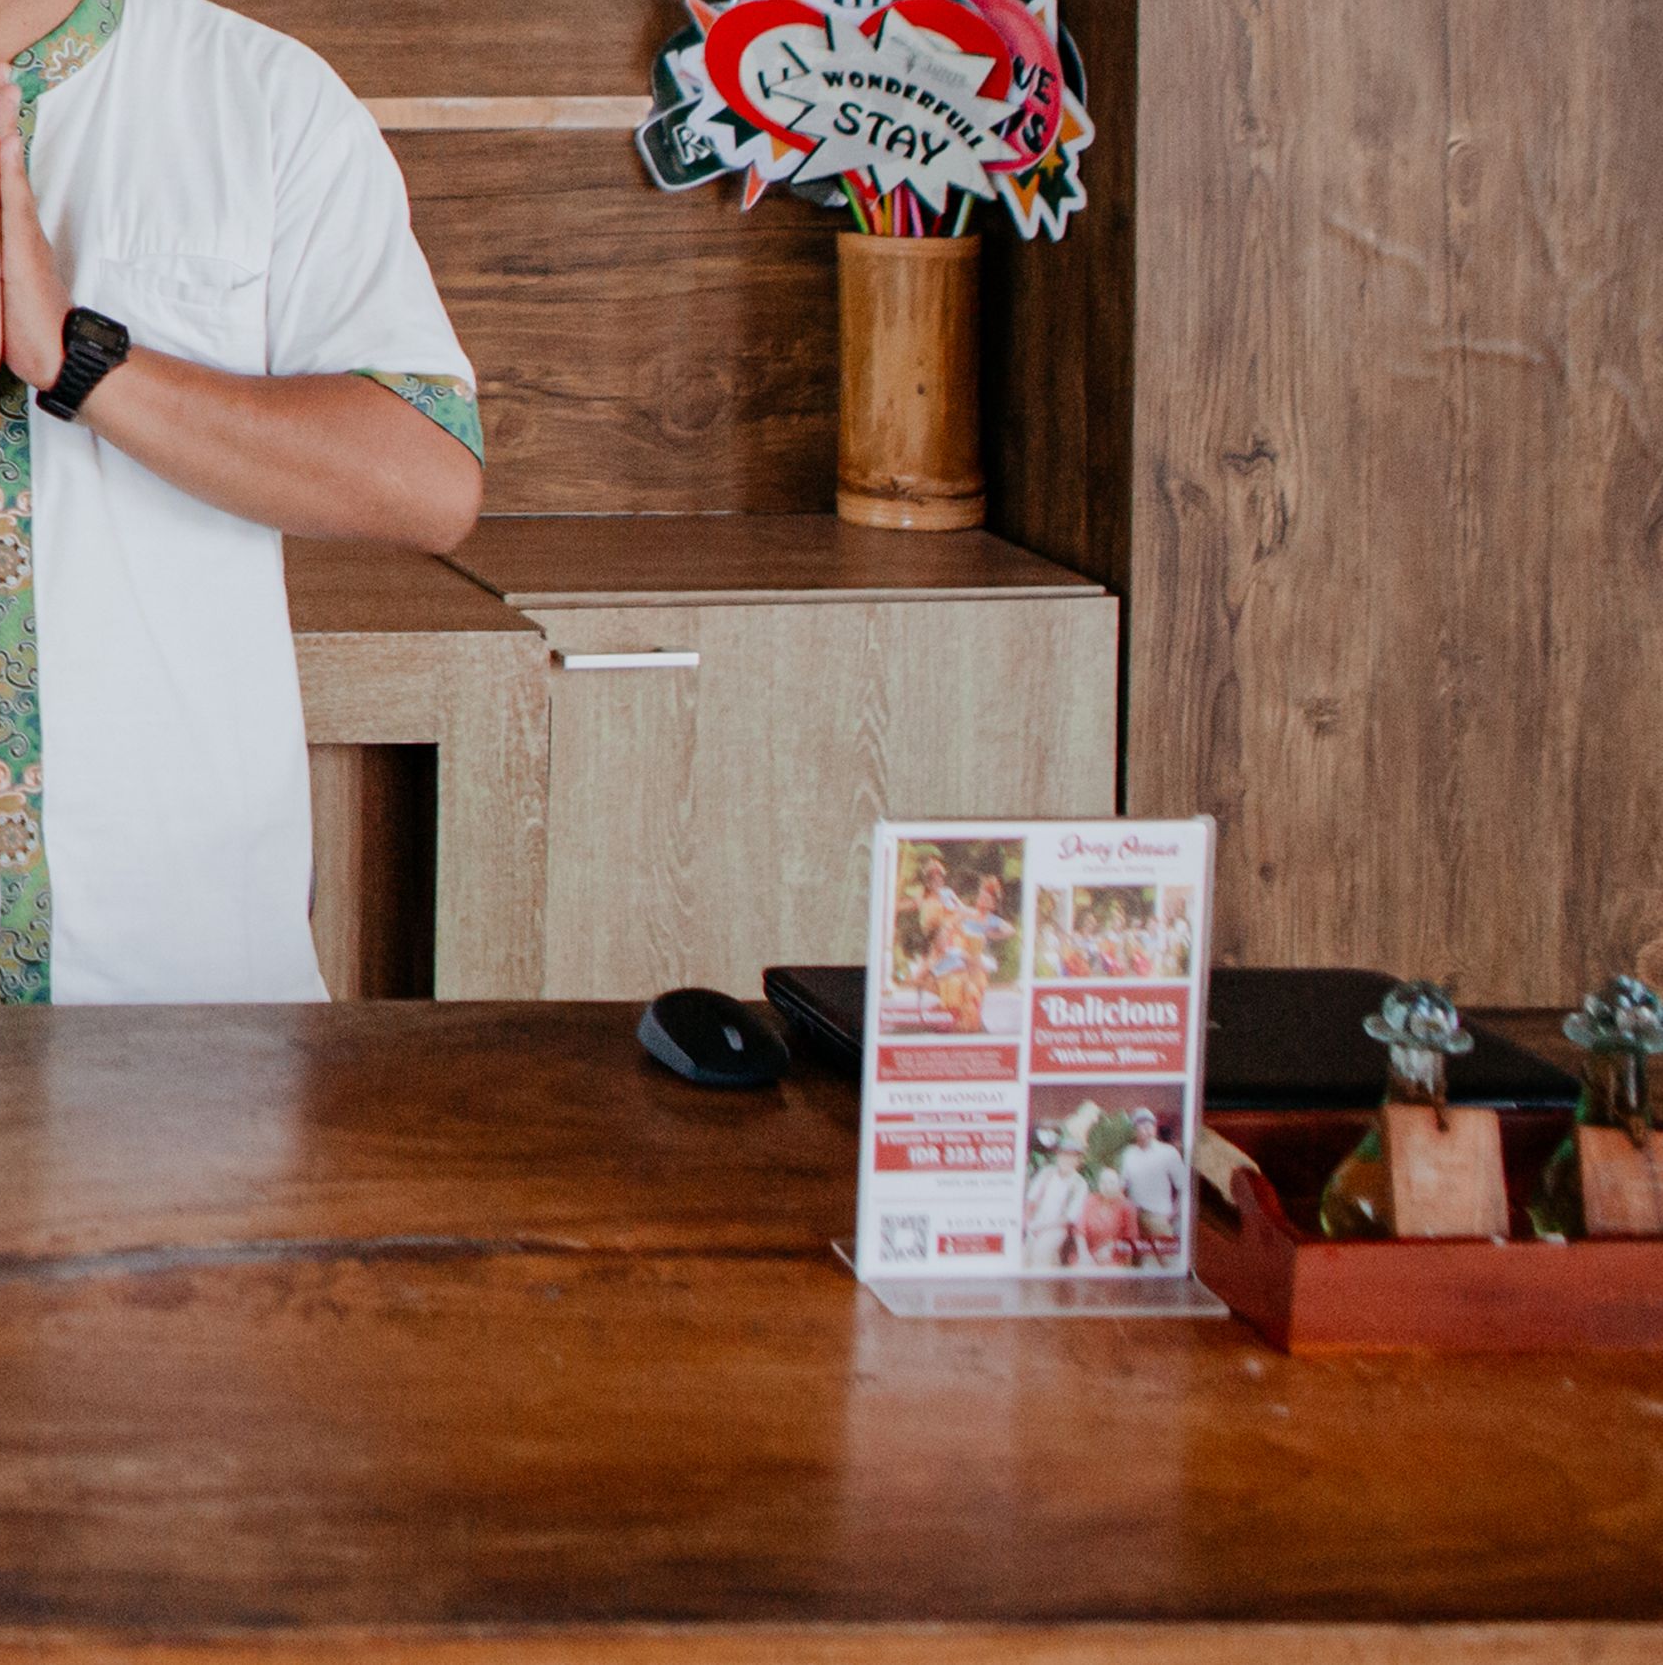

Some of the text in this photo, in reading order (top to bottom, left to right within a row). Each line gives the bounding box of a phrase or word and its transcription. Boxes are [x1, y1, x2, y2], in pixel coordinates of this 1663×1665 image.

[833, 101, 951, 167] STAY
[1039, 993, 1179, 1027] Balicious
[888, 1090, 1006, 1105] EVERY MONDAY
